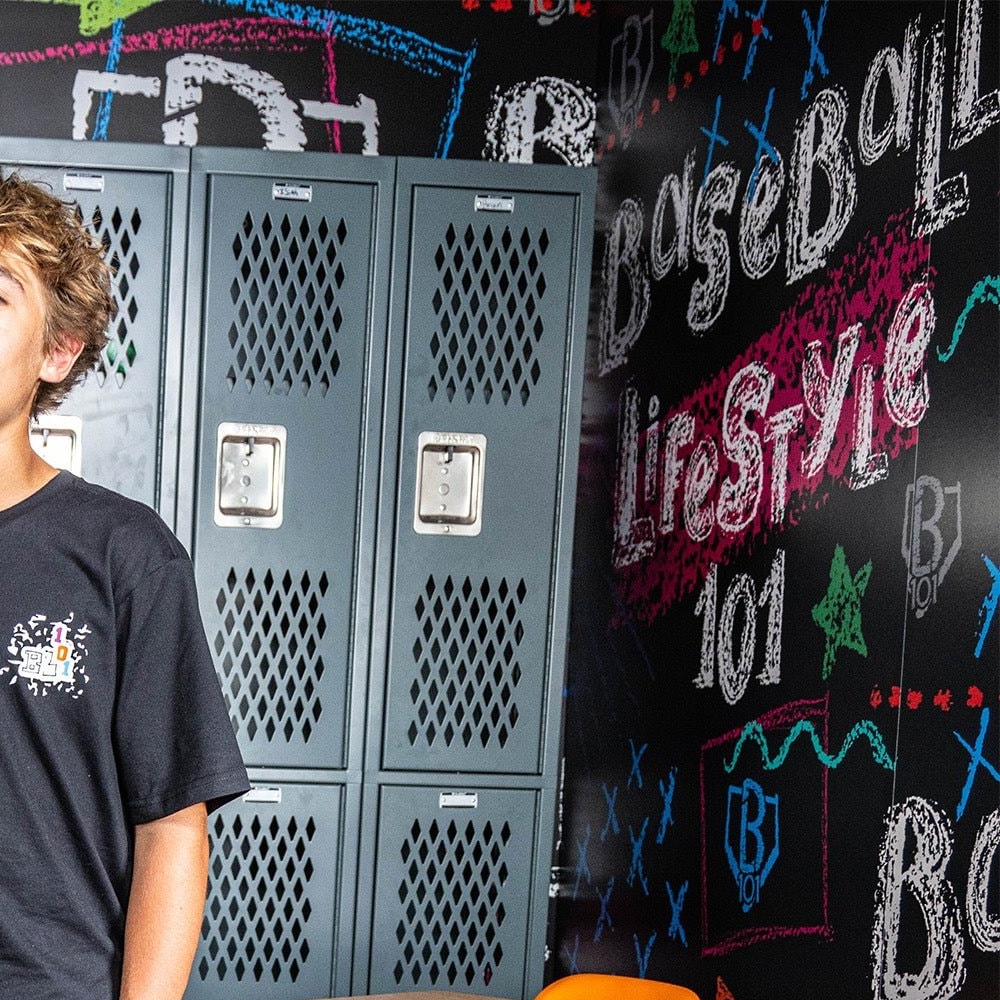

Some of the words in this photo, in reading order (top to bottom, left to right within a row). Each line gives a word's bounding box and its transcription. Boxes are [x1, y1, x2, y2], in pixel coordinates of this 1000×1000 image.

[910, 475, 945, 577] B
[693, 549, 786, 704] 101
[910, 573, 938, 610] 101
[739, 777, 766, 873] B
[738, 872, 760, 904] 101
